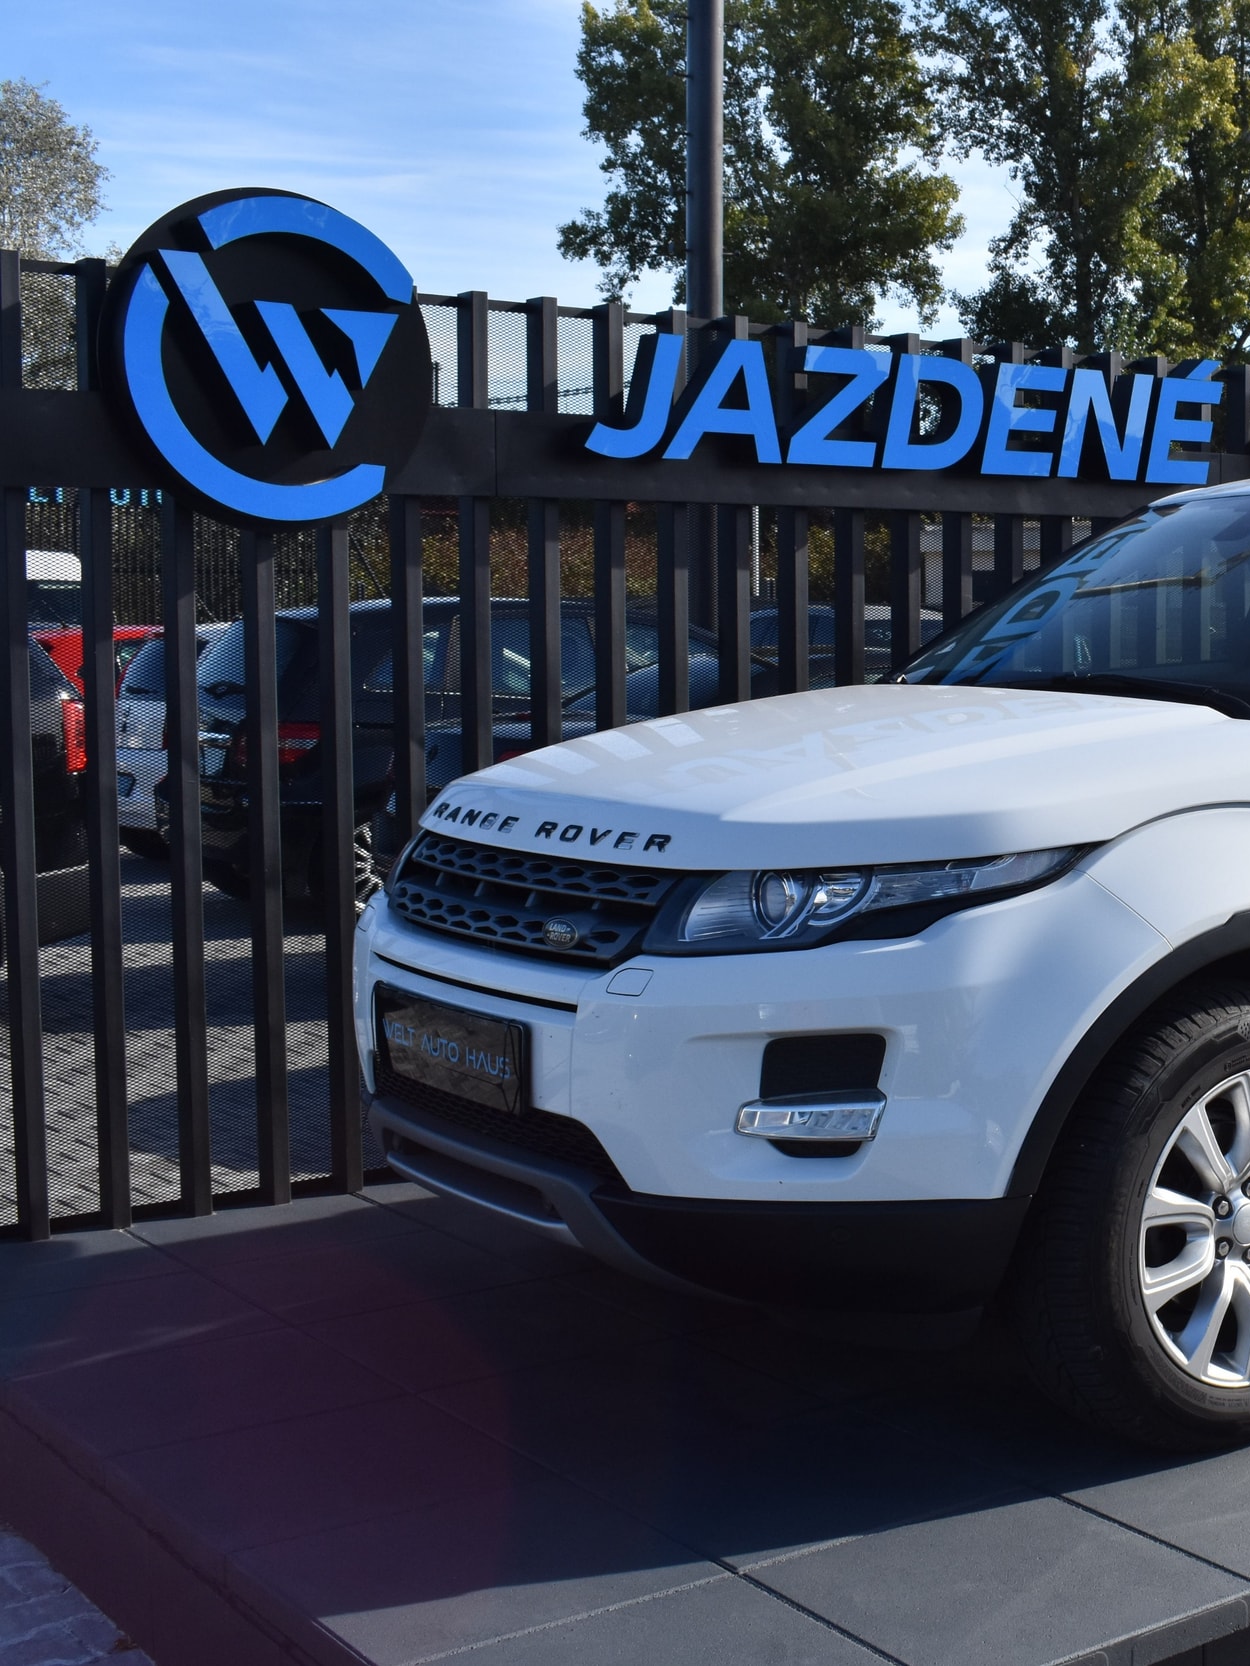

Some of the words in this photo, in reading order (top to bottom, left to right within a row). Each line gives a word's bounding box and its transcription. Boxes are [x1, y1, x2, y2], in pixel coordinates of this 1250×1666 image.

[584, 333, 1223, 485] JAZDENÉ
[432, 802, 520, 834] RANGE
[534, 821, 672, 854] ROVER
[549, 923, 567, 933] LAND
[550, 931, 571, 942] ROVER
[382, 1017, 416, 1047] WELT
[421, 1033, 460, 1063] AUTO
[465, 1046, 512, 1079] HAUS
